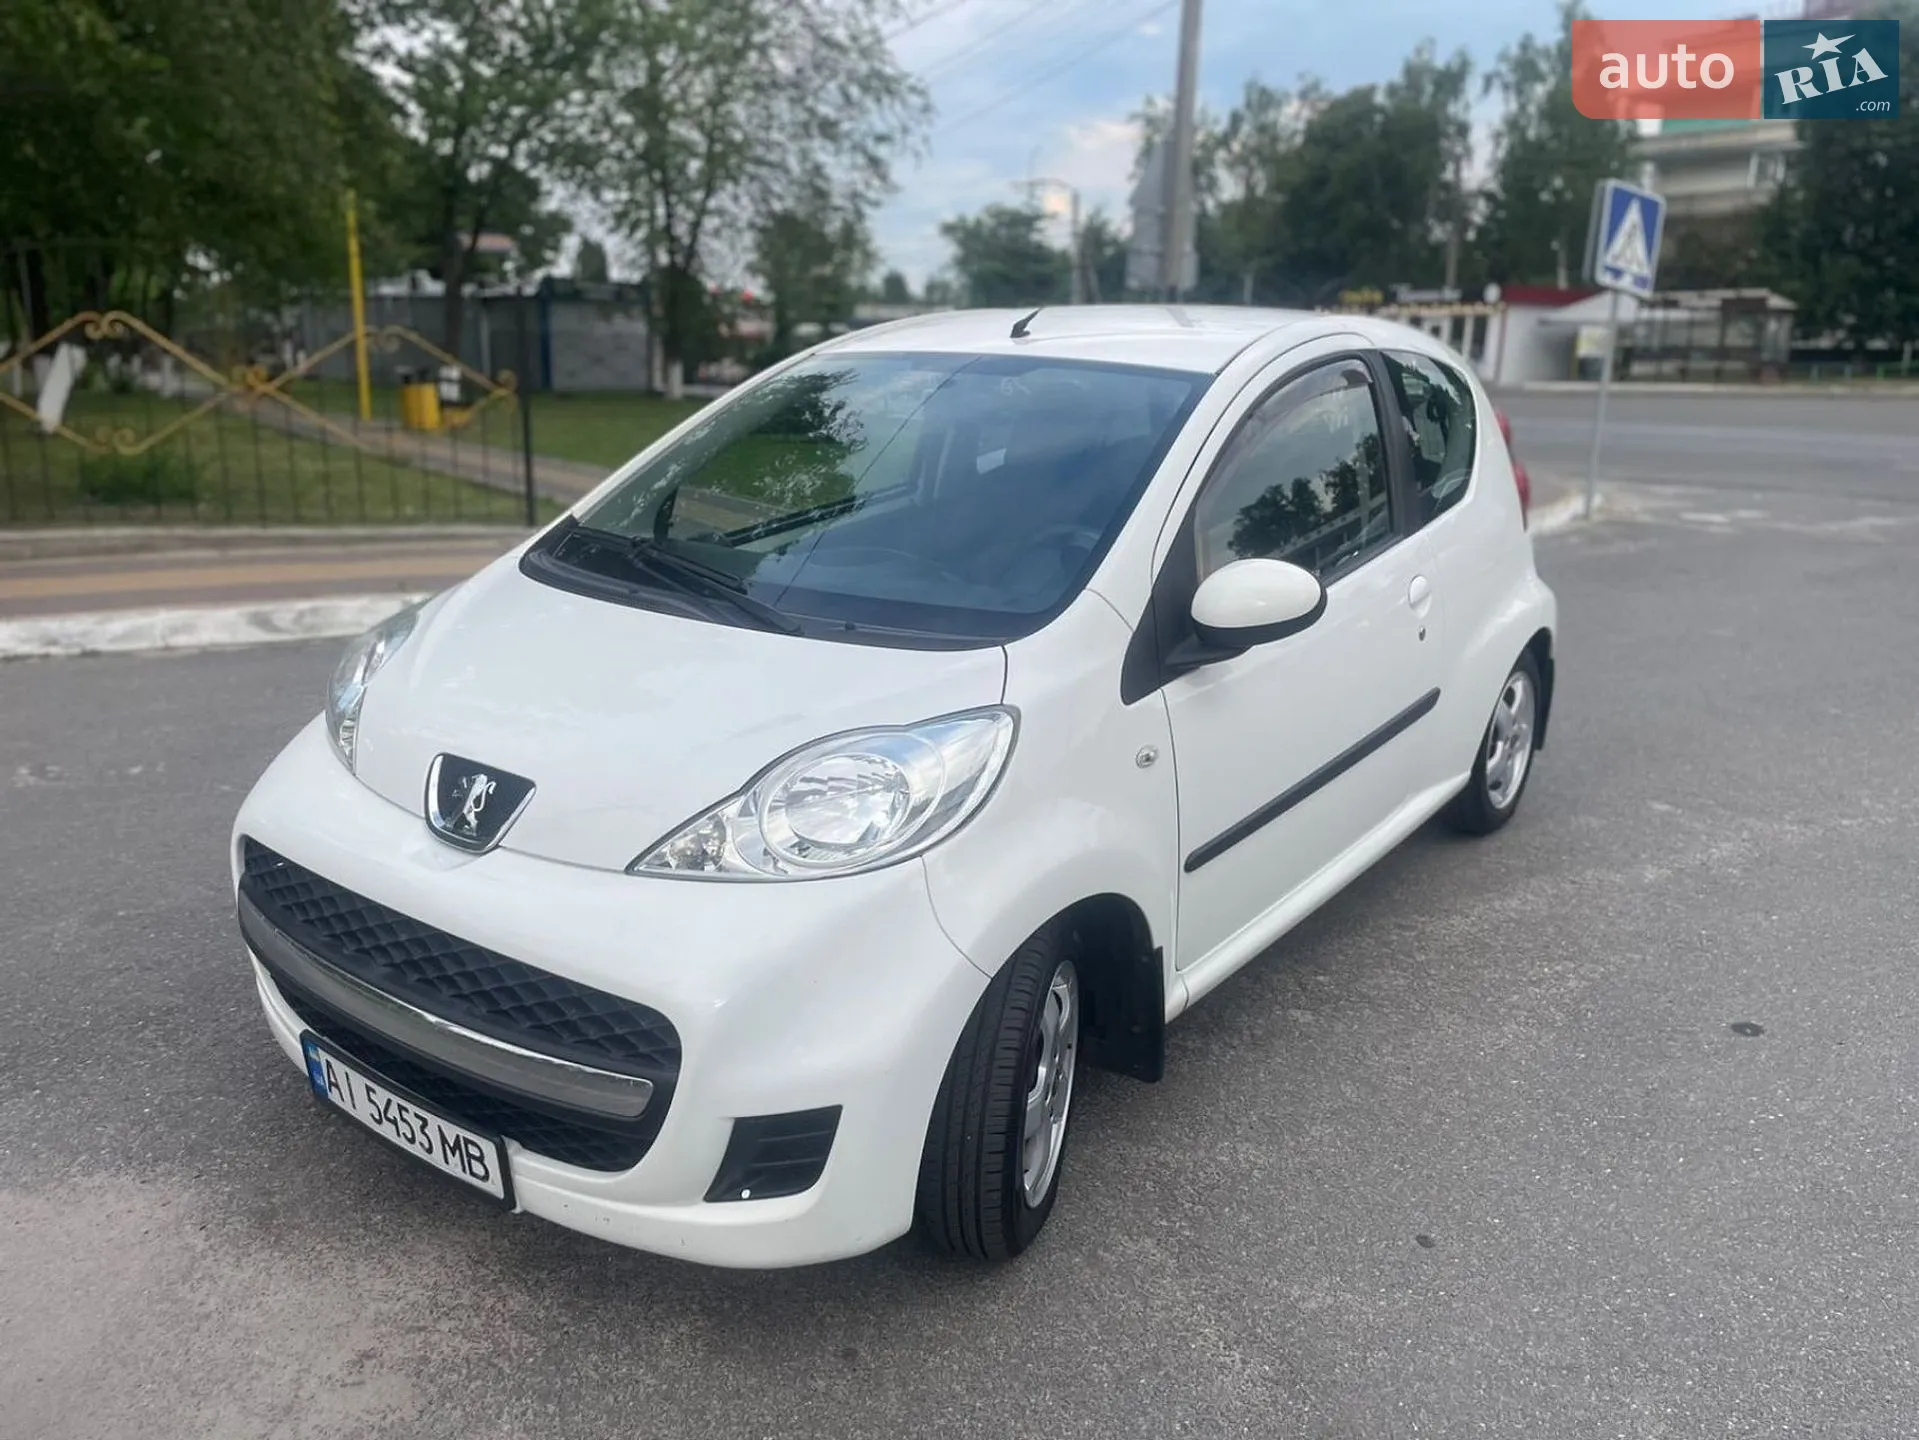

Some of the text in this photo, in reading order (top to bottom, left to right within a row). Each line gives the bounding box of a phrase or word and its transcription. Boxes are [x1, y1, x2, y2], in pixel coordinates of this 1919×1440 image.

[326, 1059, 490, 1183] AI 5453 MB
